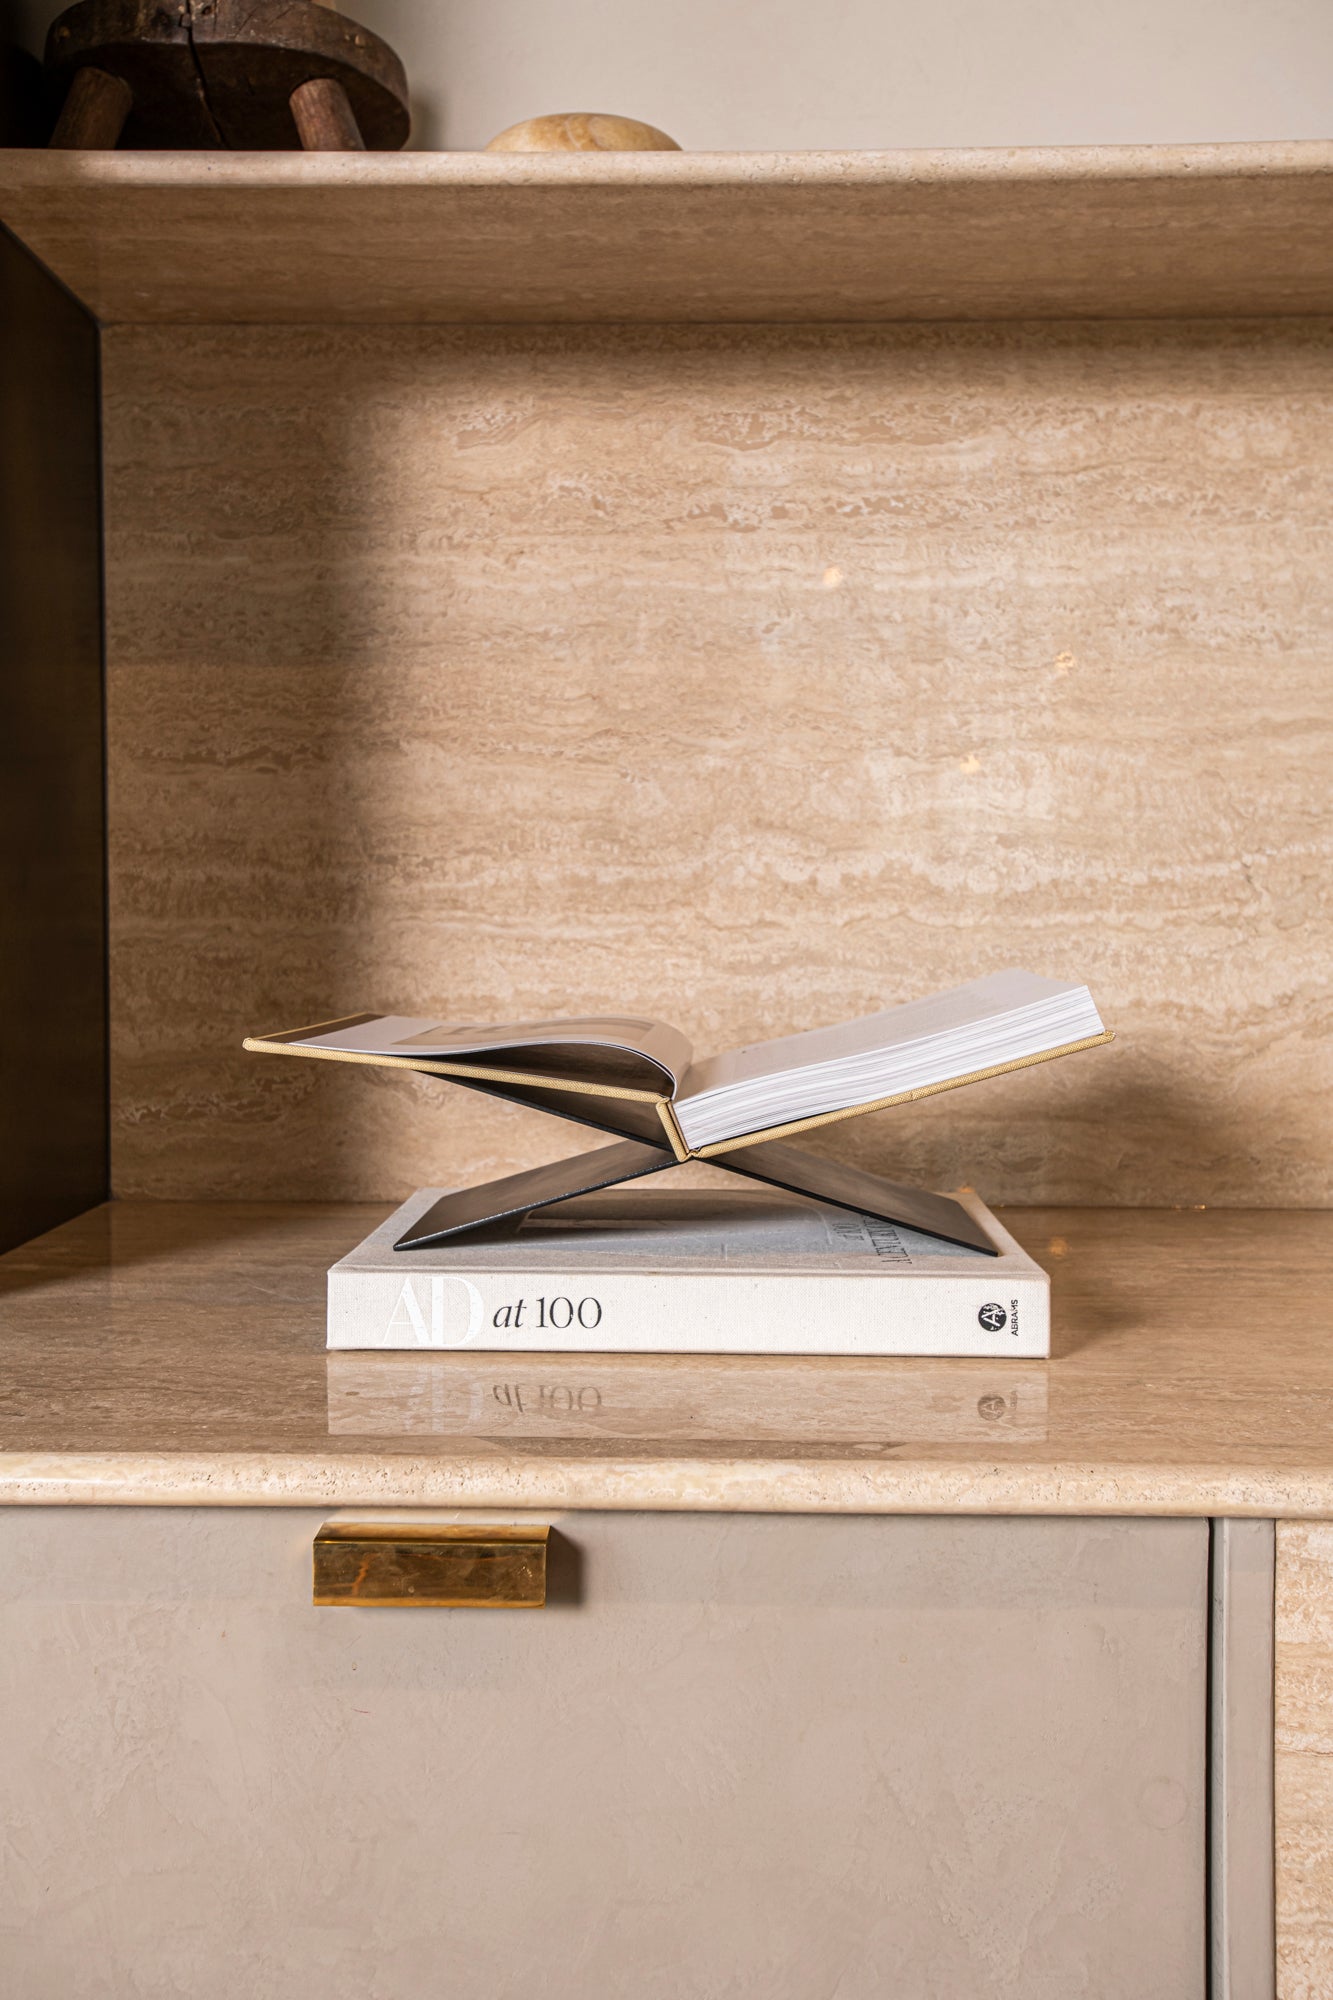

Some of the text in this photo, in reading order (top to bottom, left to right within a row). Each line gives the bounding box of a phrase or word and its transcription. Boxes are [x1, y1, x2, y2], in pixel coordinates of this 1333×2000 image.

[376, 1276, 603, 1347] AD at 100
[1010, 1299, 1019, 1337] ABRAMS
